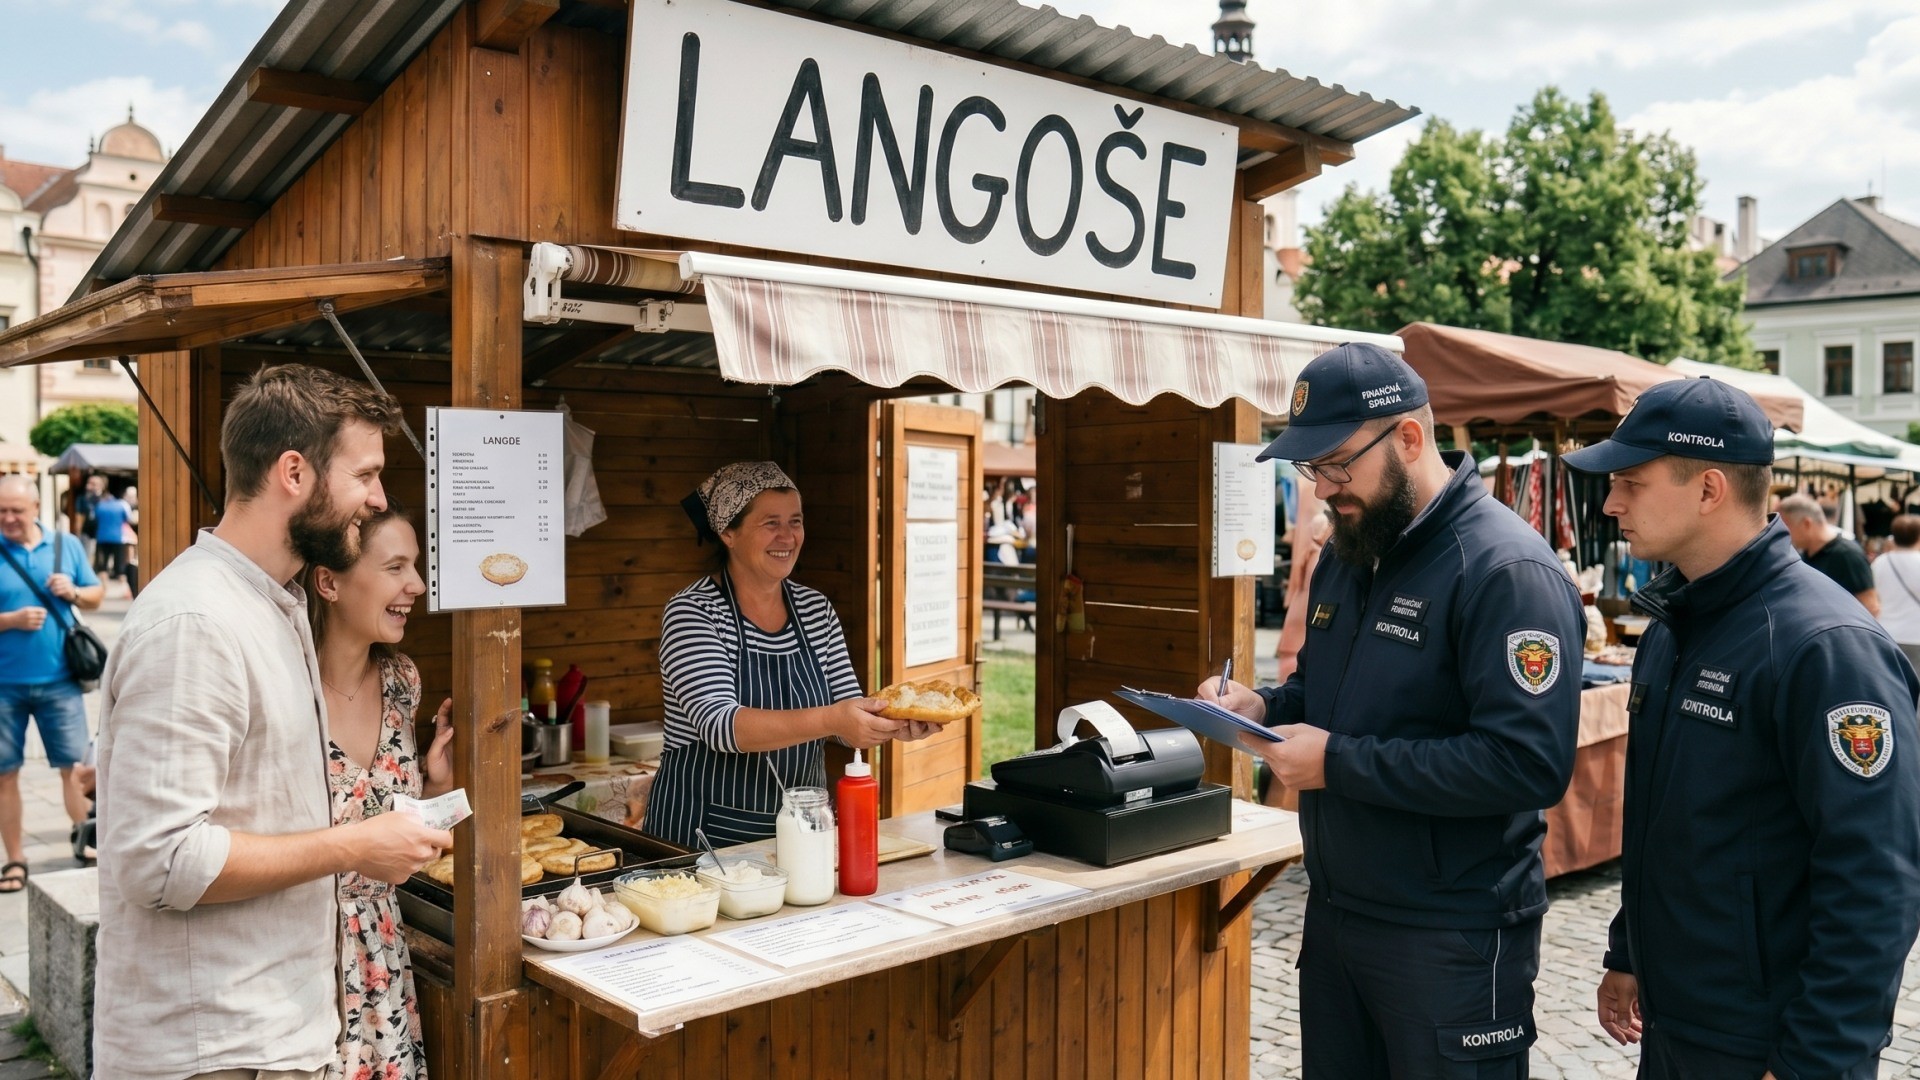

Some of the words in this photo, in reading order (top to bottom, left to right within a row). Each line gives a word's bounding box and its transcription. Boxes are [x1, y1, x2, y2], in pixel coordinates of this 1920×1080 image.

[671, 32, 1206, 279] LANGOŠE
[1667, 431, 1724, 448] KONTROLA
[1462, 1025, 1524, 1047] KONTROLA
